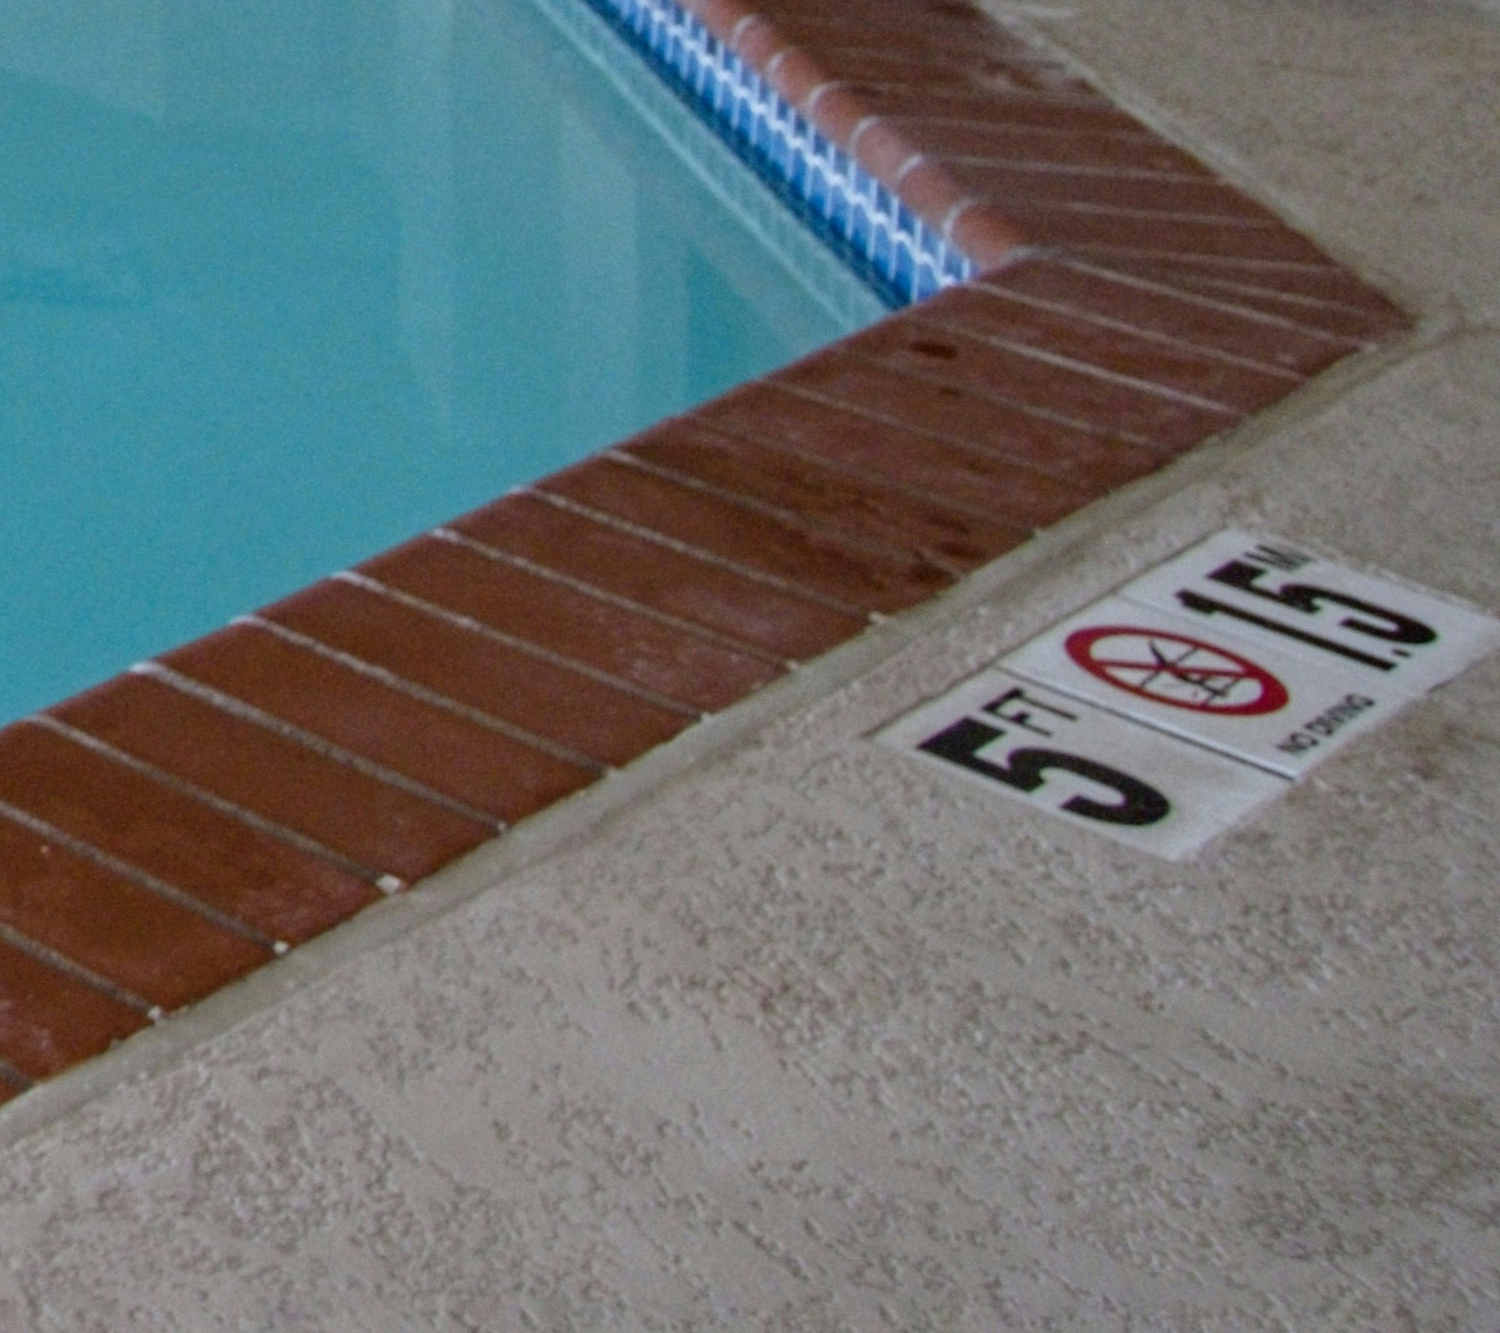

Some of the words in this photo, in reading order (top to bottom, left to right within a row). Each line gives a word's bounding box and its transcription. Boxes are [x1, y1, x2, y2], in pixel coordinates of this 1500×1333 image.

[981, 687, 1080, 737] FT
[1303, 693, 1375, 737] DIVING
[1275, 731, 1319, 754] NO
[915, 716, 1171, 826] 5
